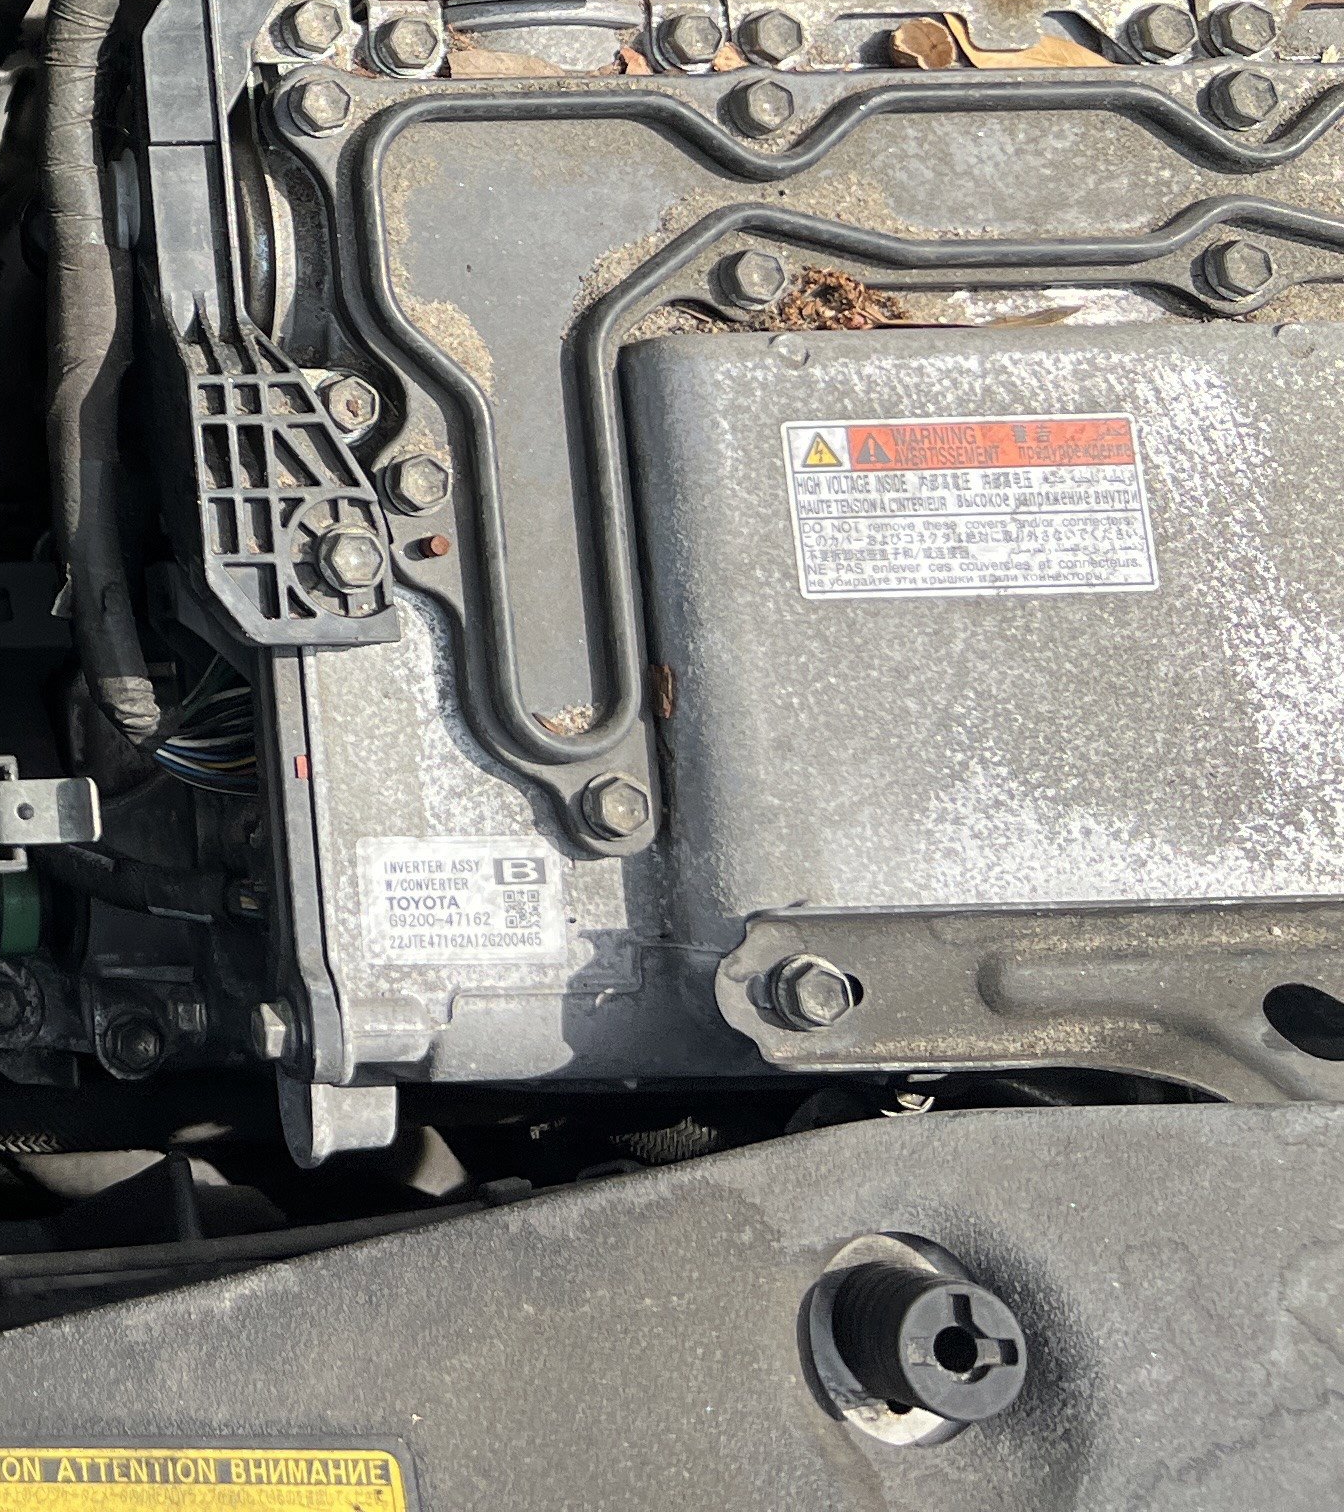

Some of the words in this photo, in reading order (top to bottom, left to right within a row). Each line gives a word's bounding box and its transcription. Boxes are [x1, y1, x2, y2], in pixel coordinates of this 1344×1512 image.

[892, 425, 977, 447] WARNING
[894, 445, 999, 467] AVERTISSEMENT
[796, 475, 821, 495] HIGH
[825, 474, 871, 494] VOLTAGE
[874, 473, 908, 493] INSIDE
[798, 498, 832, 515] HAUTE
[834, 497, 877, 514] TENSION
[802, 521, 823, 534] DO
[831, 520, 860, 534] NOT
[867, 521, 915, 533] remove
[922, 519, 957, 532] these
[965, 517, 1007, 530] covers
[807, 563, 828, 575] NE
[836, 562, 865, 574] PAS
[872, 561, 921, 574] enlever
[928, 561, 952, 572] ces
[384, 860, 442, 875] INVERTER
[451, 859, 481, 873] ASSY
[502, 859, 539, 883] B
[385, 878, 469, 892] W/CONVERTER
[386, 894, 460, 911] TOYOTA
[389, 912, 491, 928] G9200-47162
[57, 1457, 216, 1483] ATTENTION
[230, 1458, 386, 1485] ВНИМАНИЕ
